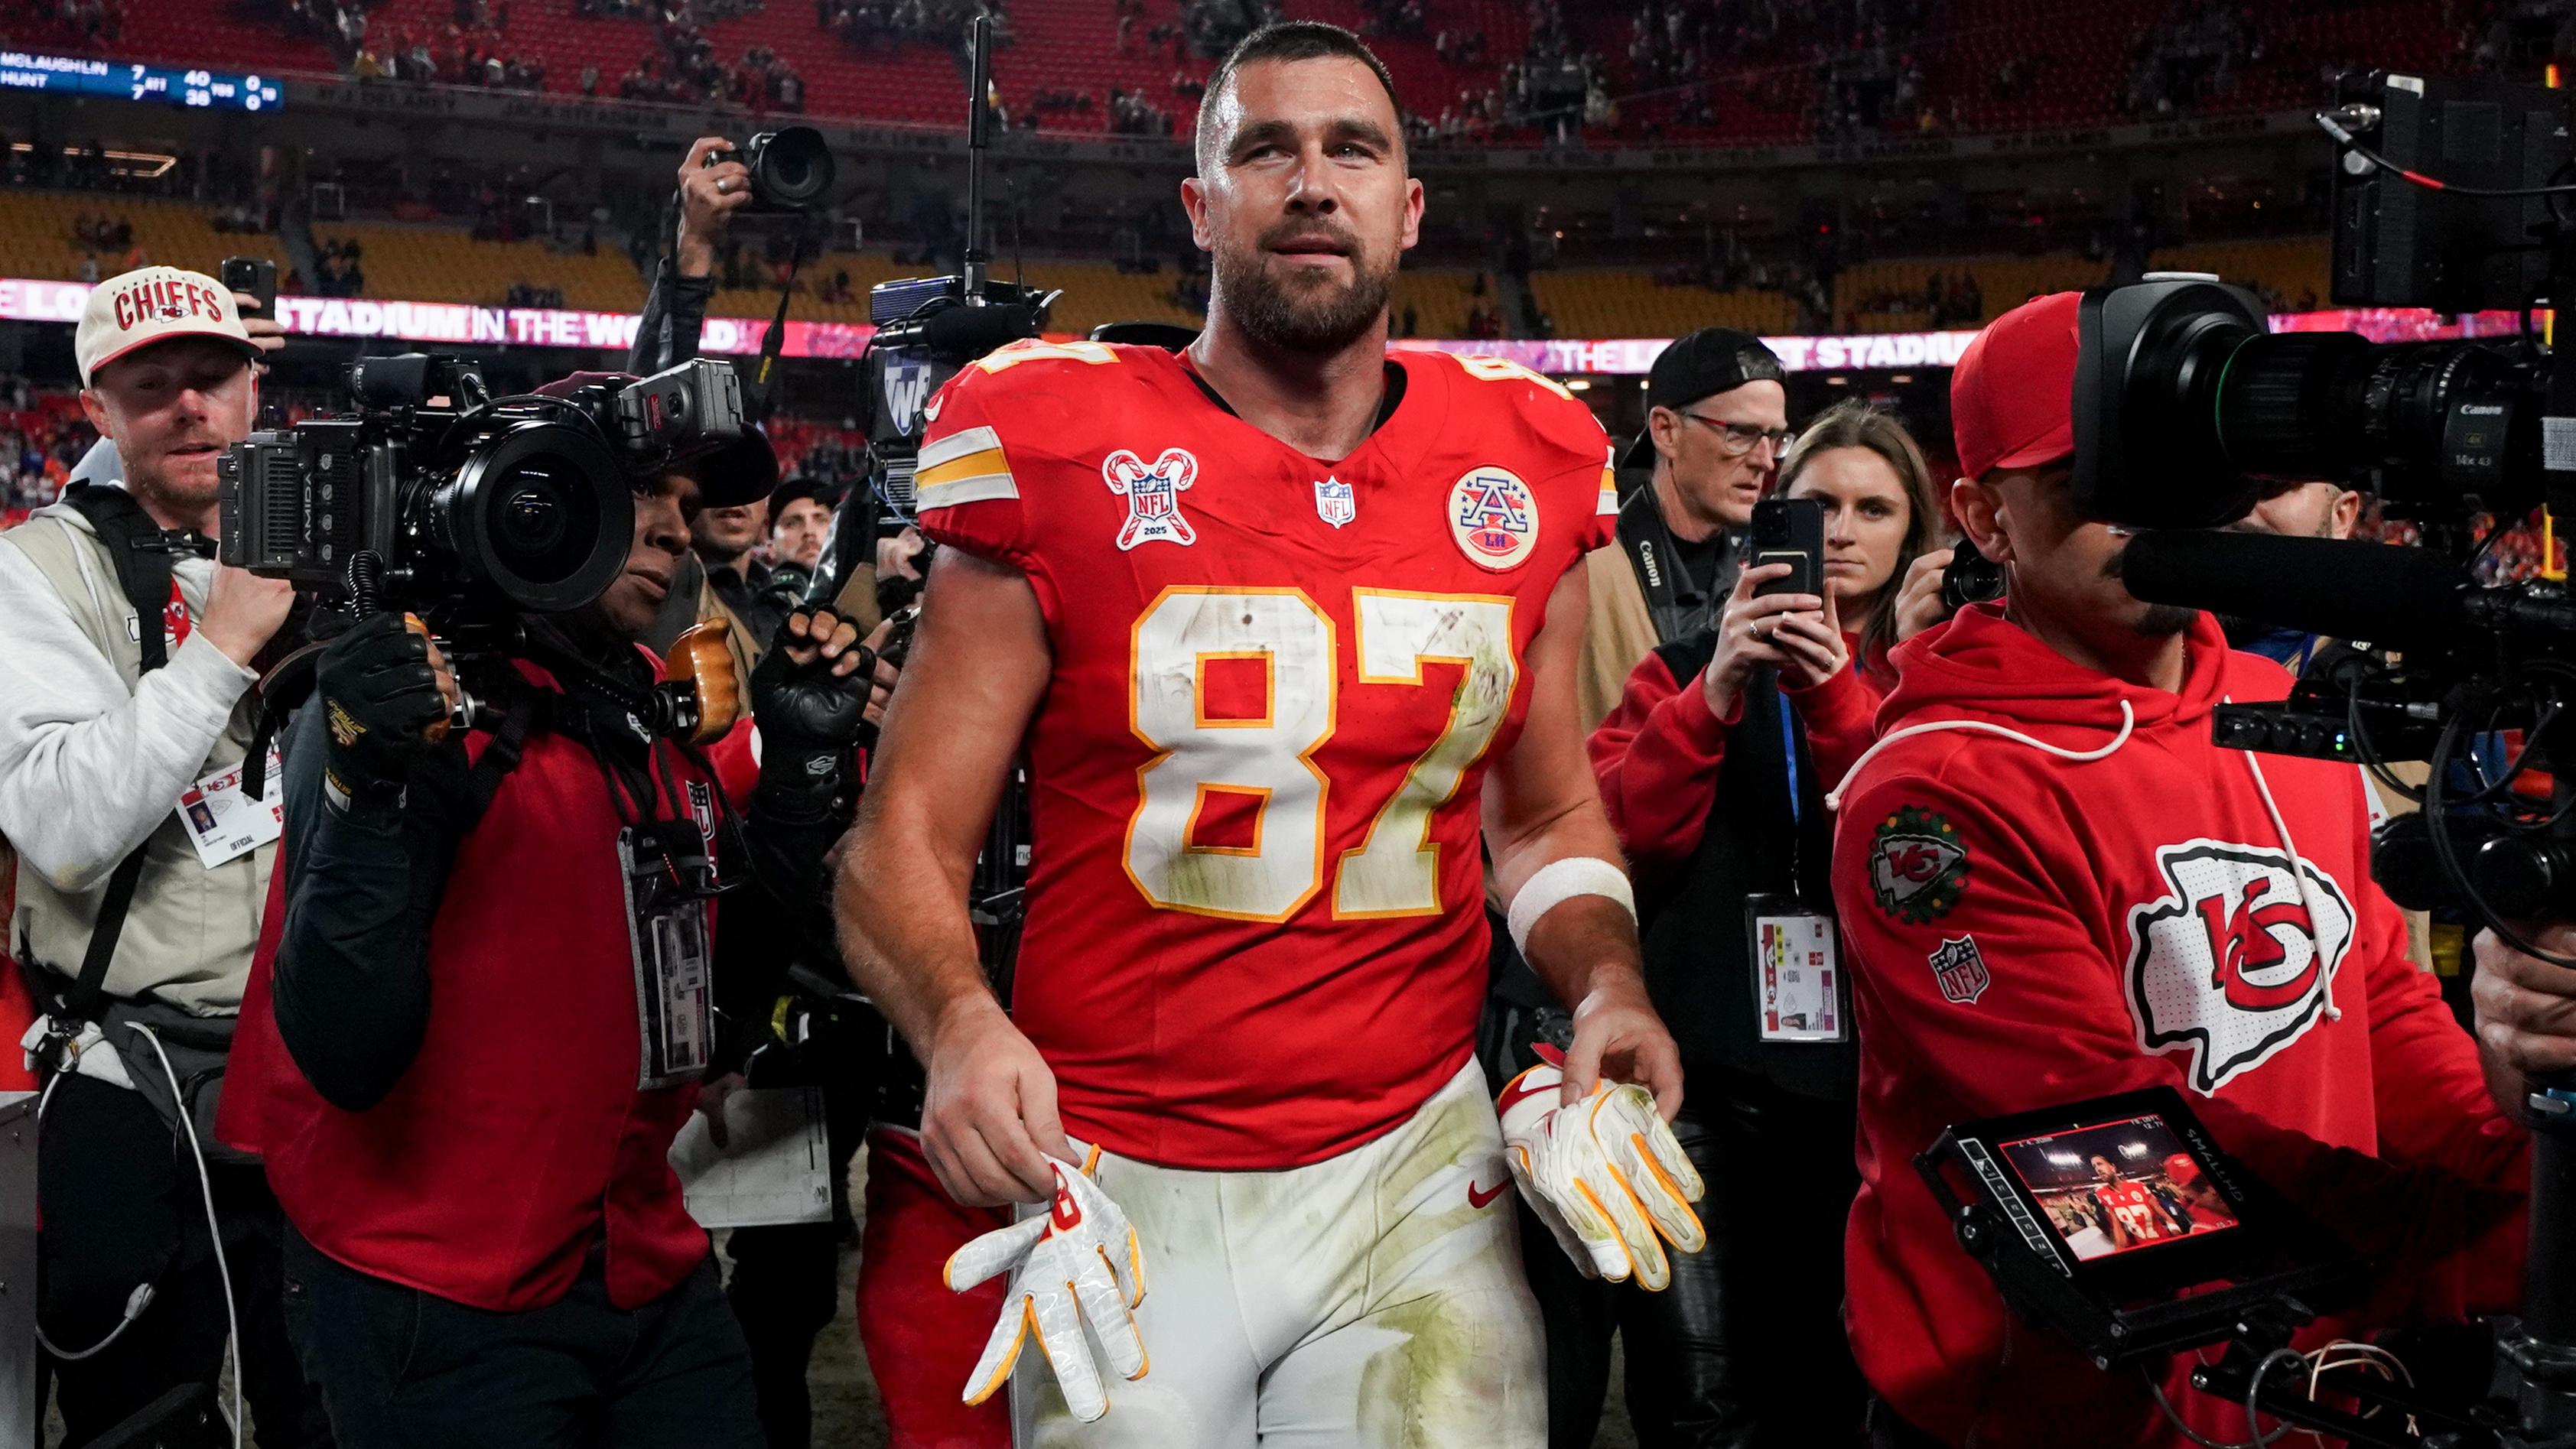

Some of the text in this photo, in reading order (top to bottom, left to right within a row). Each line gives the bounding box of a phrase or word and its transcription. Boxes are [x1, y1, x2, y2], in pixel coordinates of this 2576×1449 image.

[0, 70, 48, 88] HUNT
[132, 84, 145, 100] 7
[246, 95, 261, 111] 0
[132, 64, 145, 80] 7
[184, 70, 210, 87] 40
[246, 75, 261, 91] 0
[114, 281, 222, 331] CHIEFS
[472, 307, 506, 342] IN
[509, 310, 582, 346] THE
[1558, 341, 1615, 372] THE
[2460, 404, 2503, 415] Canon
[1136, 491, 1169, 514] NFL
[1324, 499, 1349, 518] NFL
[1144, 525, 1167, 536] 2025
[1484, 533, 1506, 547] LH
[1639, 540, 1661, 587] Canon
[1121, 583, 1520, 924] 87
[229, 834, 255, 851] OFFICIAL
[1941, 960, 1984, 996] NFL
[2114, 1203, 2161, 1240] 87
